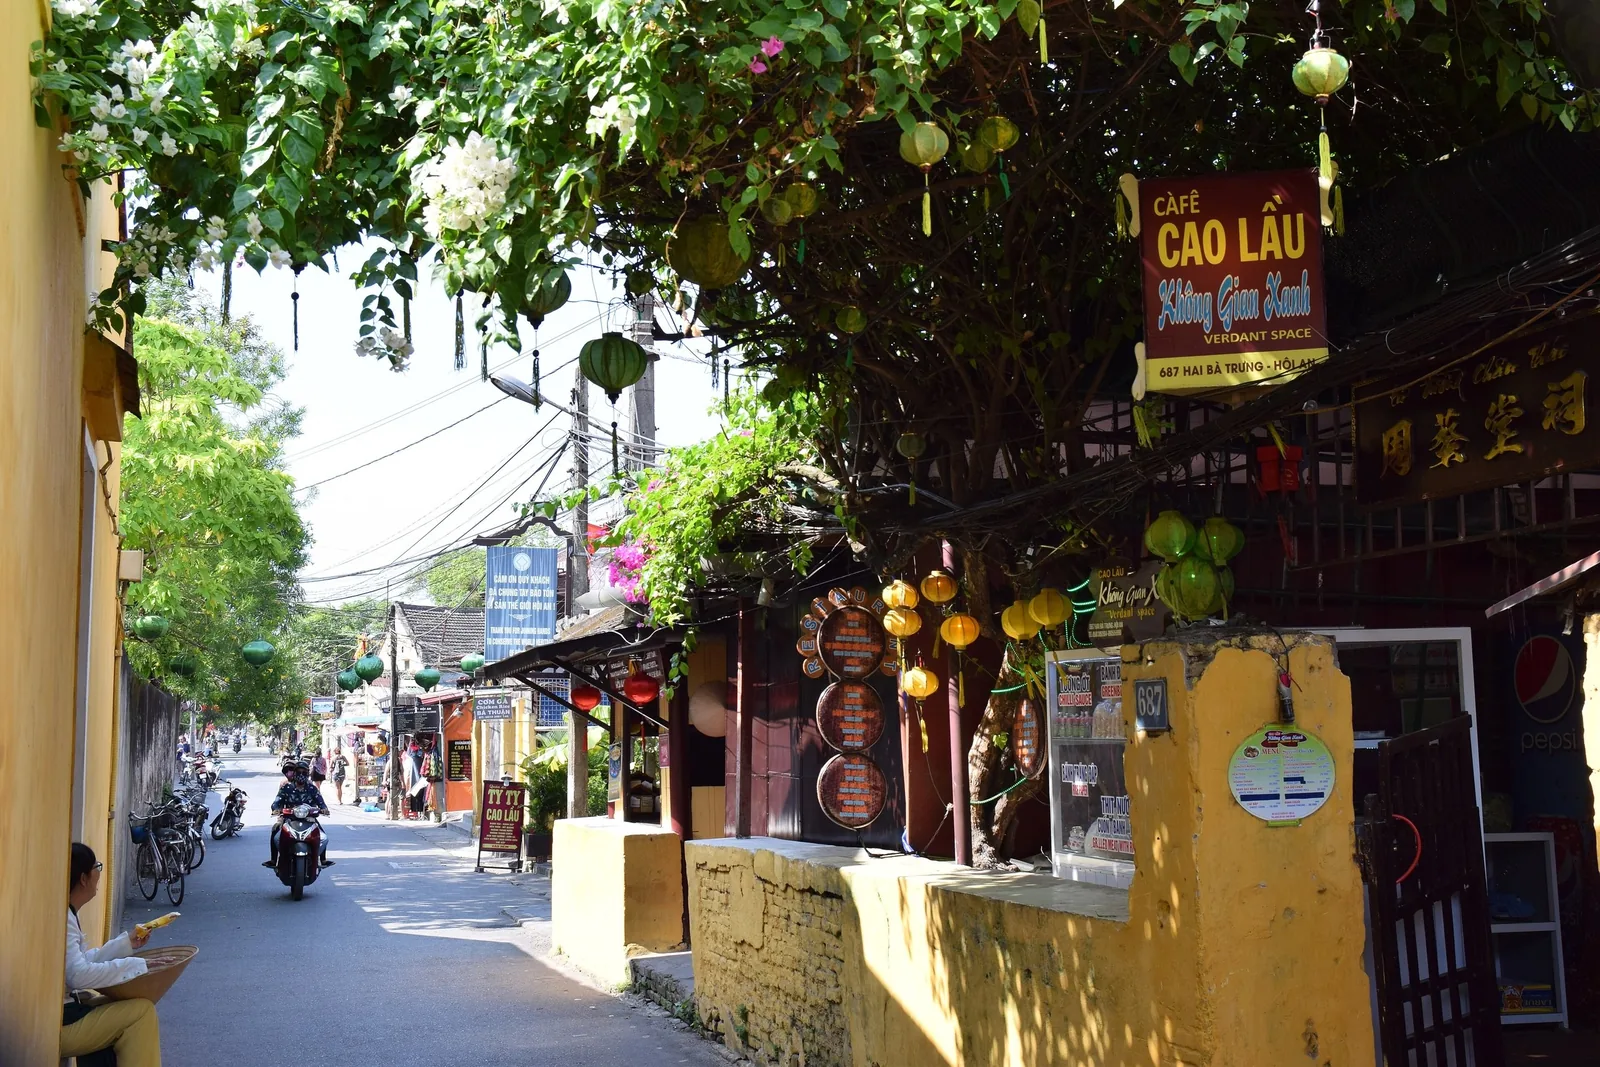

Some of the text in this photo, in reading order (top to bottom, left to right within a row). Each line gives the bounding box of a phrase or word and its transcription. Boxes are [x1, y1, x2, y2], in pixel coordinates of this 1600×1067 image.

[1153, 189, 1200, 217] CÀFÊ
[1158, 195, 1305, 268] CAO LẦU
[1158, 269, 1311, 333] Không Gian Xanh
[1204, 328, 1312, 345] VERDANT SPACE
[1159, 366, 1180, 378] 687
[1183, 365, 1204, 376] HAI
[1207, 361, 1222, 375] BÀ
[1225, 362, 1264, 374] TRƯNG
[1098, 569, 1111, 579] CAO
[1098, 581, 1124, 608] Không
[1136, 608, 1156, 620] space
[801, 588, 898, 674] RESTAURNT
[1074, 692, 1092, 706] SAUCE
[1137, 685, 1162, 716] 687
[1521, 728, 1577, 754] pepsi
[488, 789, 521, 806] TY TY
[486, 808, 502, 821] CAO
[1107, 838, 1119, 852] MEAT
